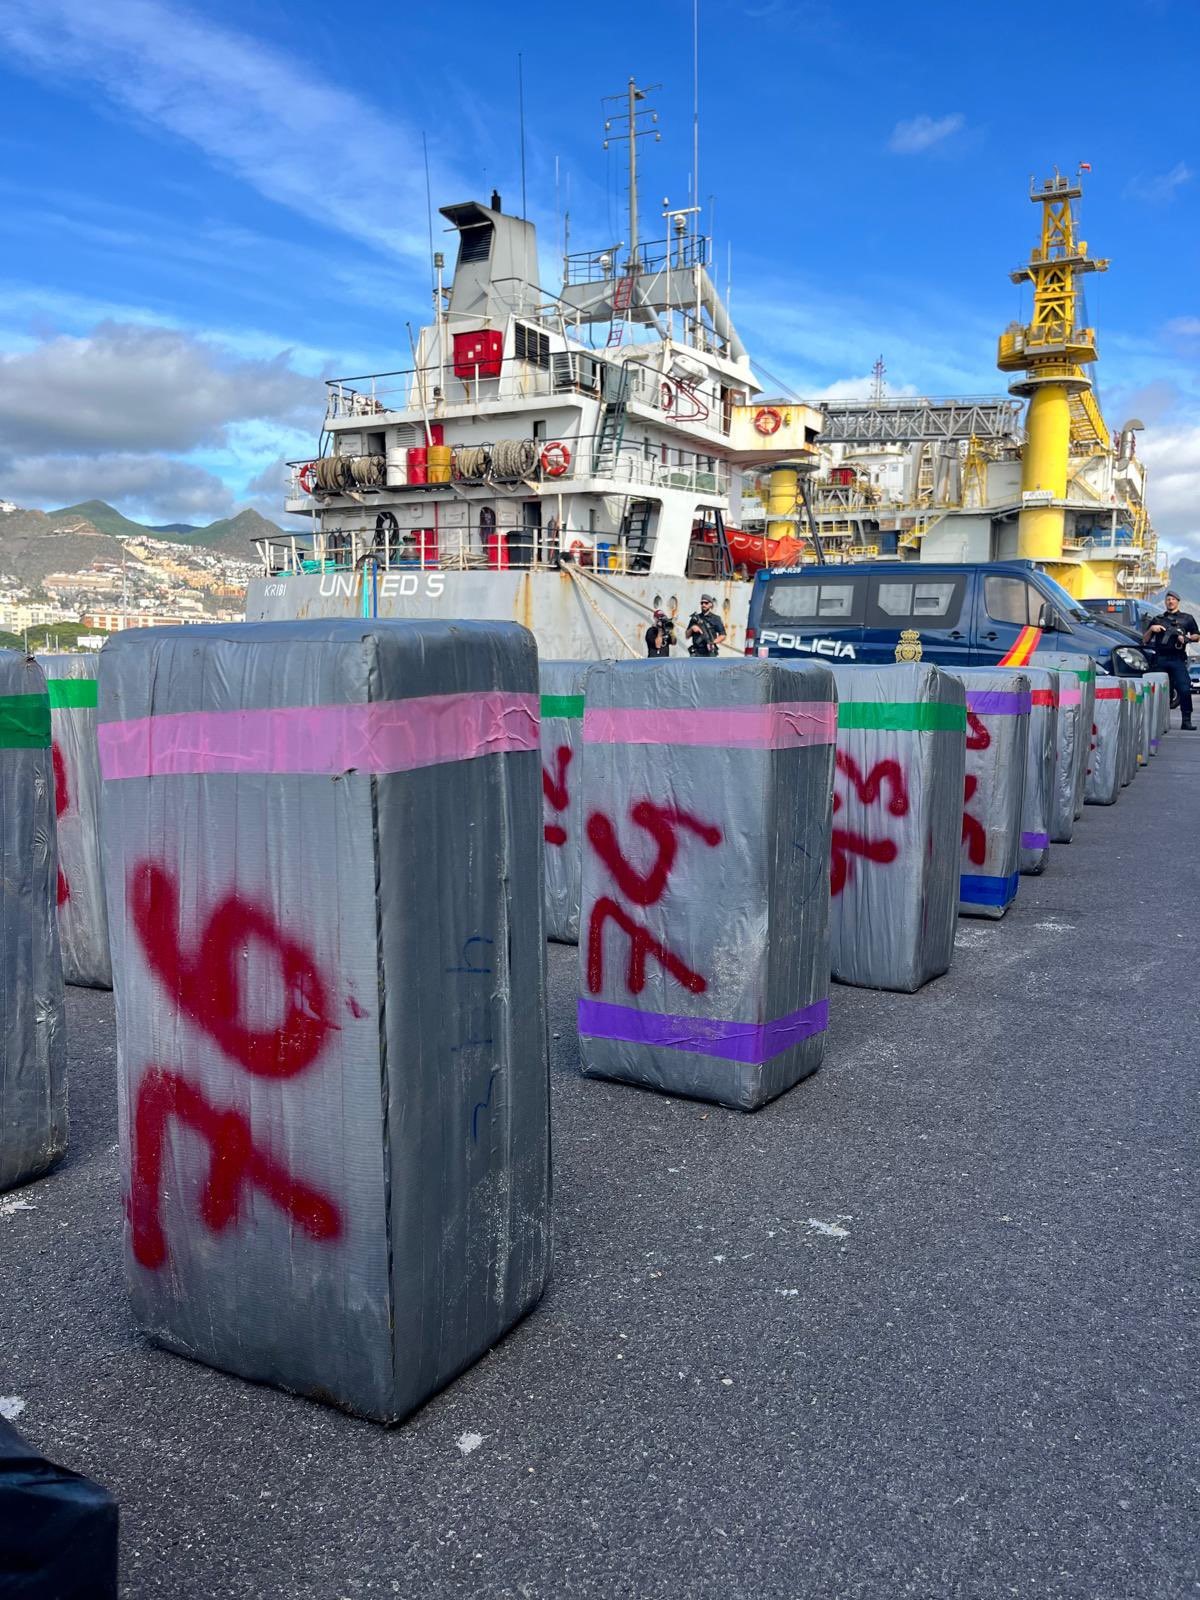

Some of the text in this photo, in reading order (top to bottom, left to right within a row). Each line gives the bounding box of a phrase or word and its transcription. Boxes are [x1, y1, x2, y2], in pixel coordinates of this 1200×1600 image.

[264, 583, 287, 596] KRIBI
[759, 630, 856, 659] POLICÍA
[127, 861, 343, 1270] 76
